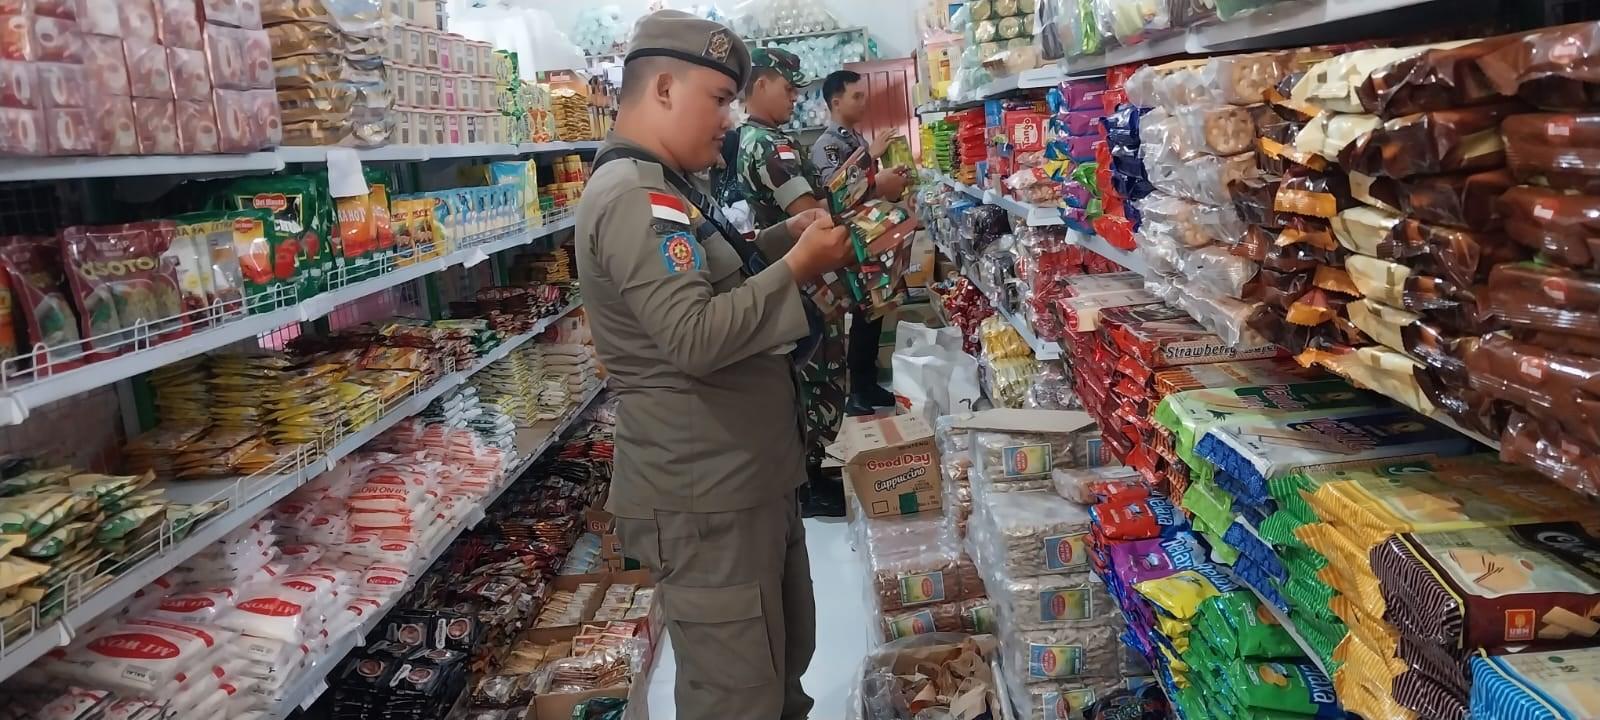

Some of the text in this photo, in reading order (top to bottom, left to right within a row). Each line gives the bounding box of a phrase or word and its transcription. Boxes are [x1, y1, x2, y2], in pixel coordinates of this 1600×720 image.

[1022, 118, 1034, 148] Tango
[1166, 343, 1237, 358] Strawberry
[866, 453, 931, 471] Good Day
[874, 466, 926, 492] Cappuccino
[1161, 537, 1193, 570] Relax
[1509, 627, 1530, 635] UBM
[1300, 664, 1336, 703] elaxa
